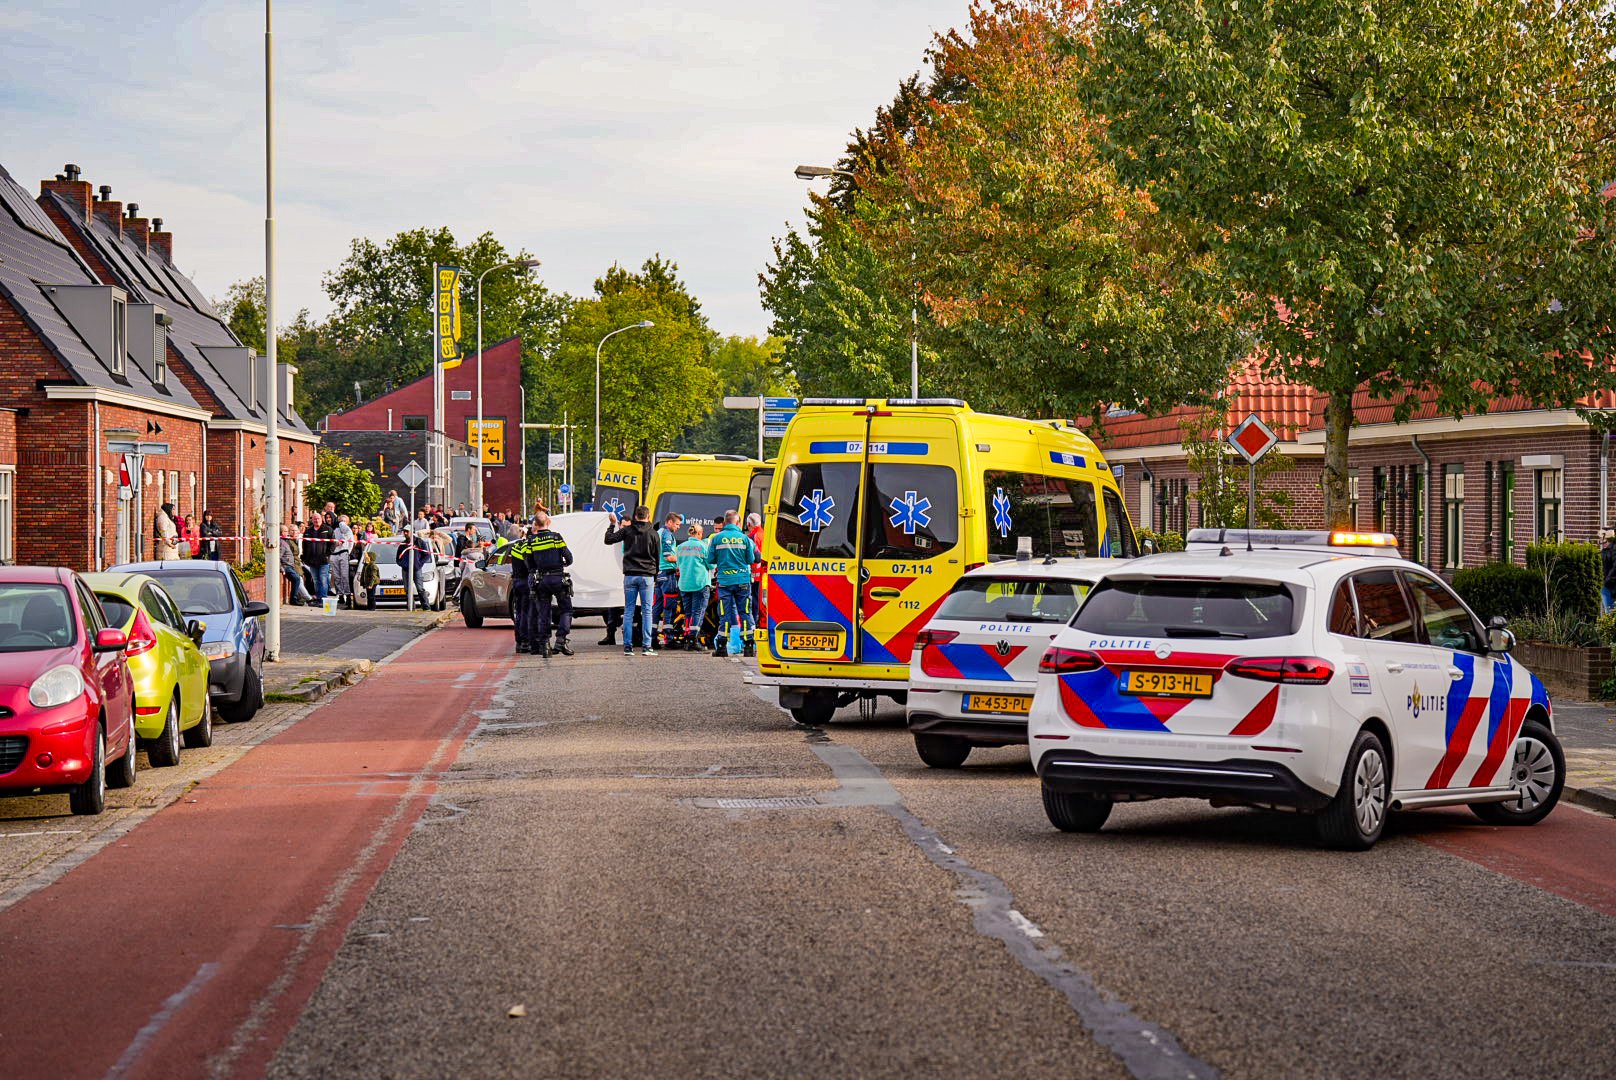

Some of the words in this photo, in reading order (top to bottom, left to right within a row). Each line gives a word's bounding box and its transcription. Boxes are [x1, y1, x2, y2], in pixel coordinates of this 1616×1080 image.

[703, 518, 715, 526] kru
[769, 561, 847, 573] AMBULANCE
[891, 563, 933, 575] 07-114
[979, 624, 1033, 634] POLITIE
[789, 635, 835, 647] P-550-PN
[1088, 640, 1152, 650] POLITIE
[1135, 674, 1203, 692] S-913-HL
[973, 696, 1028, 711] R-453-PL
